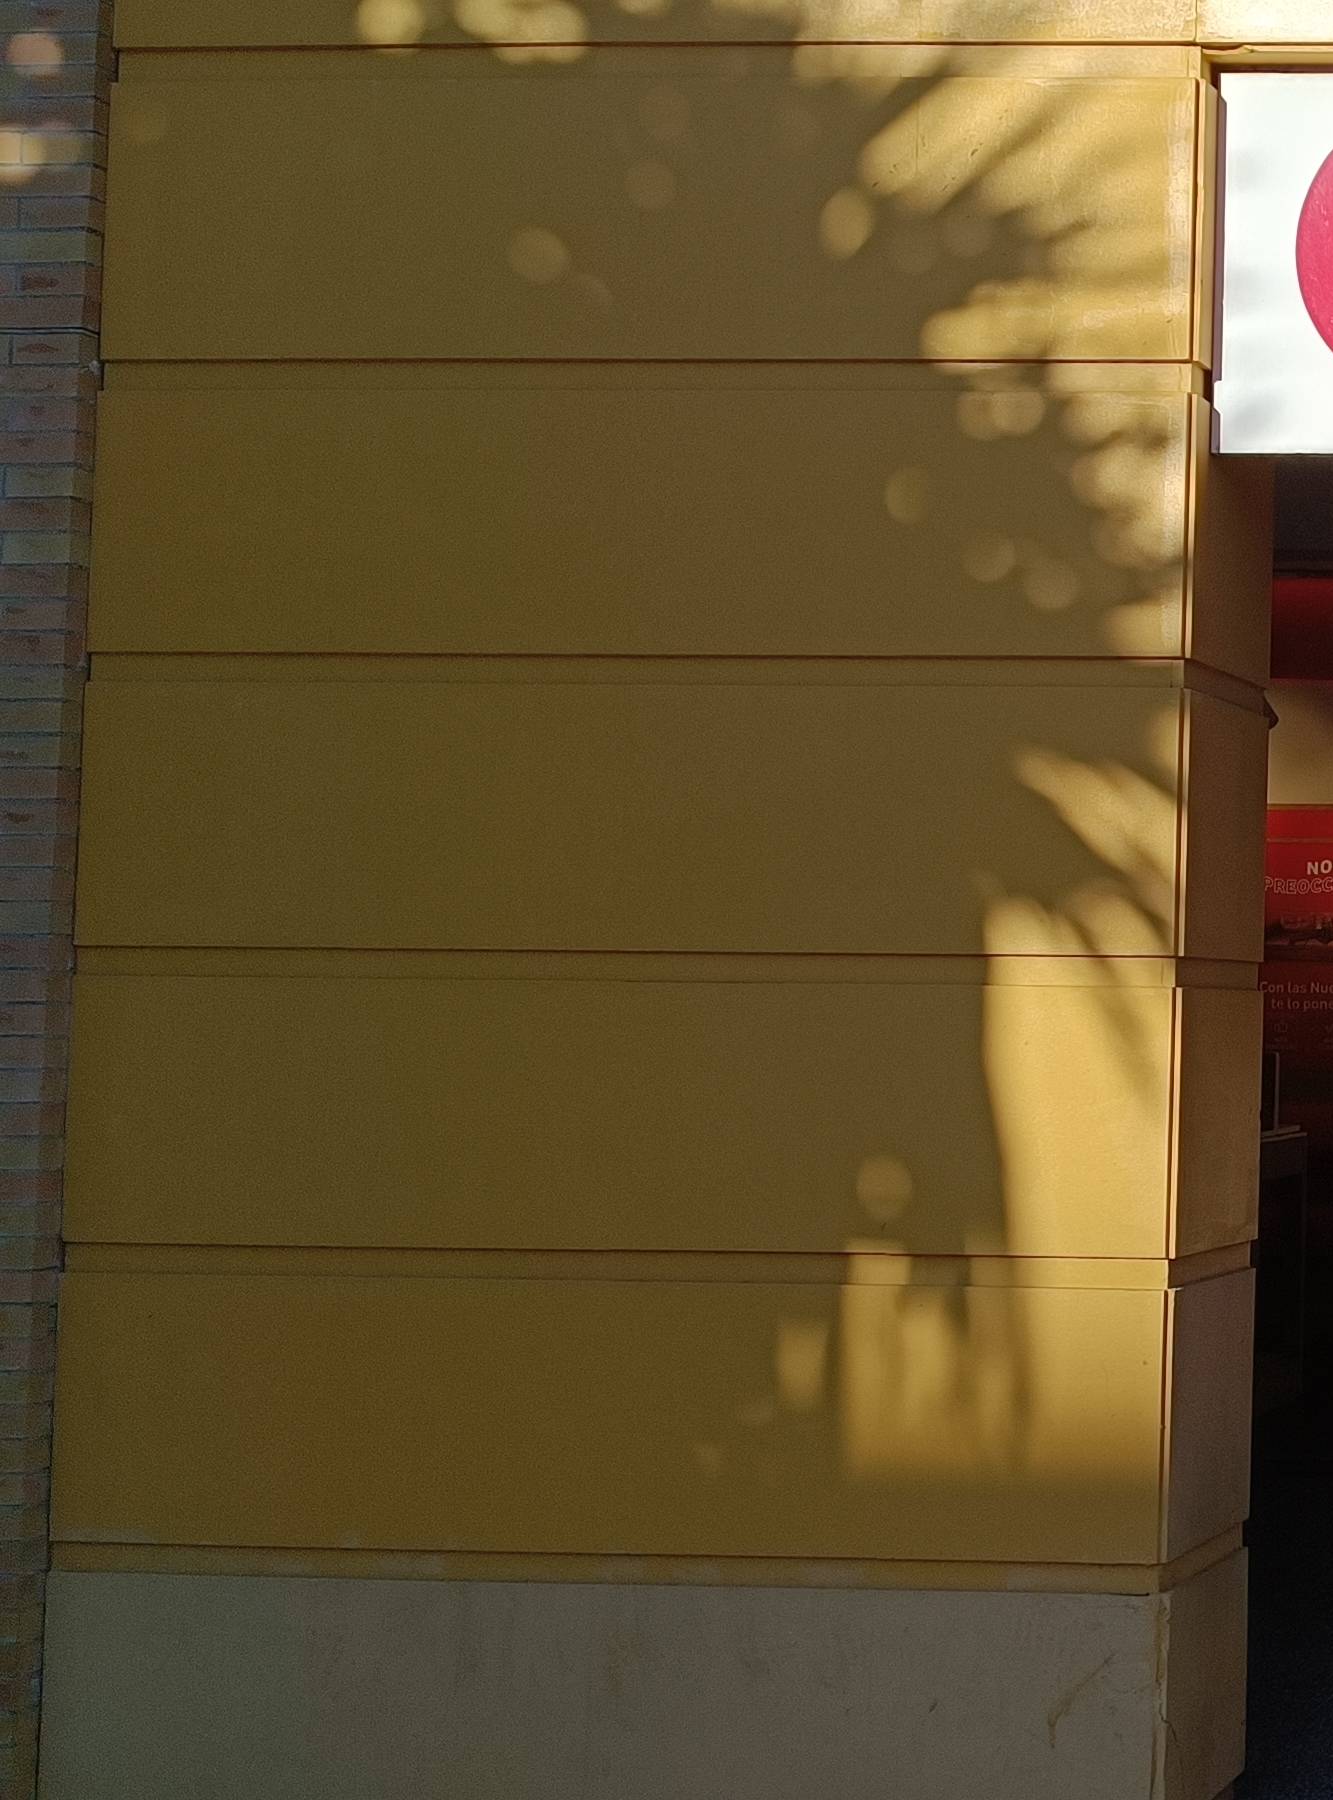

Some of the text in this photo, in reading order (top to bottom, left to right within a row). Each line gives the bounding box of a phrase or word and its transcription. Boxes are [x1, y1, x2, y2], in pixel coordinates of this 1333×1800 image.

[1259, 981, 1285, 994] Con
[1287, 981, 1307, 994] las
[1287, 997, 1301, 1010] lo
